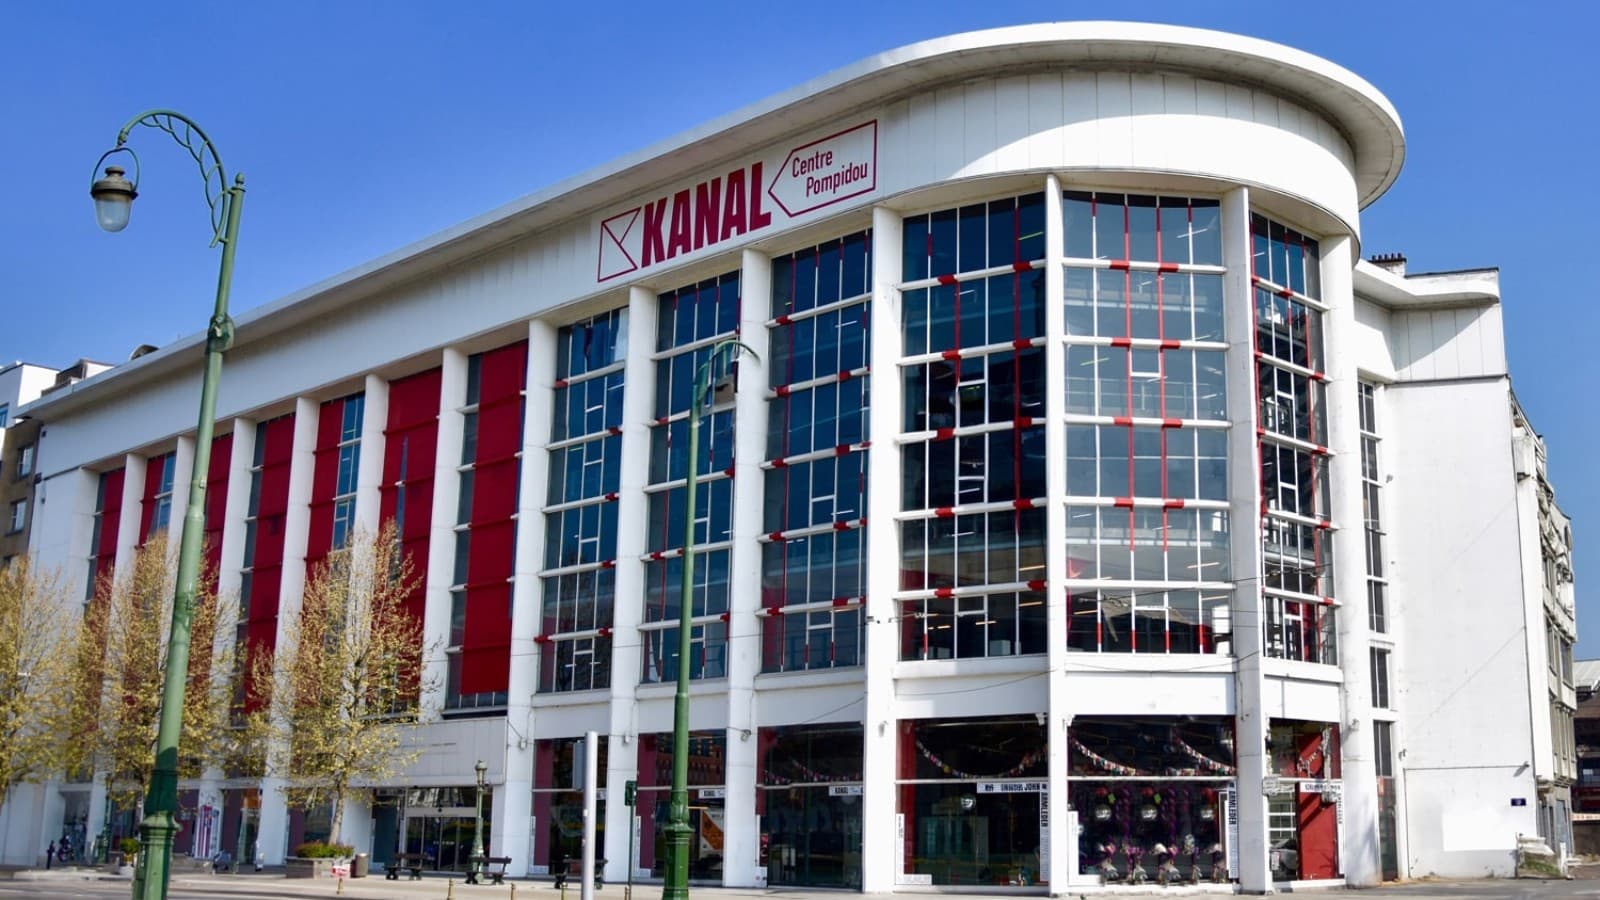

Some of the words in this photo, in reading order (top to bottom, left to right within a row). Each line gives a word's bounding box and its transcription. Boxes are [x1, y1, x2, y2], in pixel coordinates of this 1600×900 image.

[792, 150, 833, 178] Centre
[806, 161, 868, 197] Pompidou
[641, 161, 772, 268] KANAL
[1228, 790, 1237, 825] ARMLEDER
